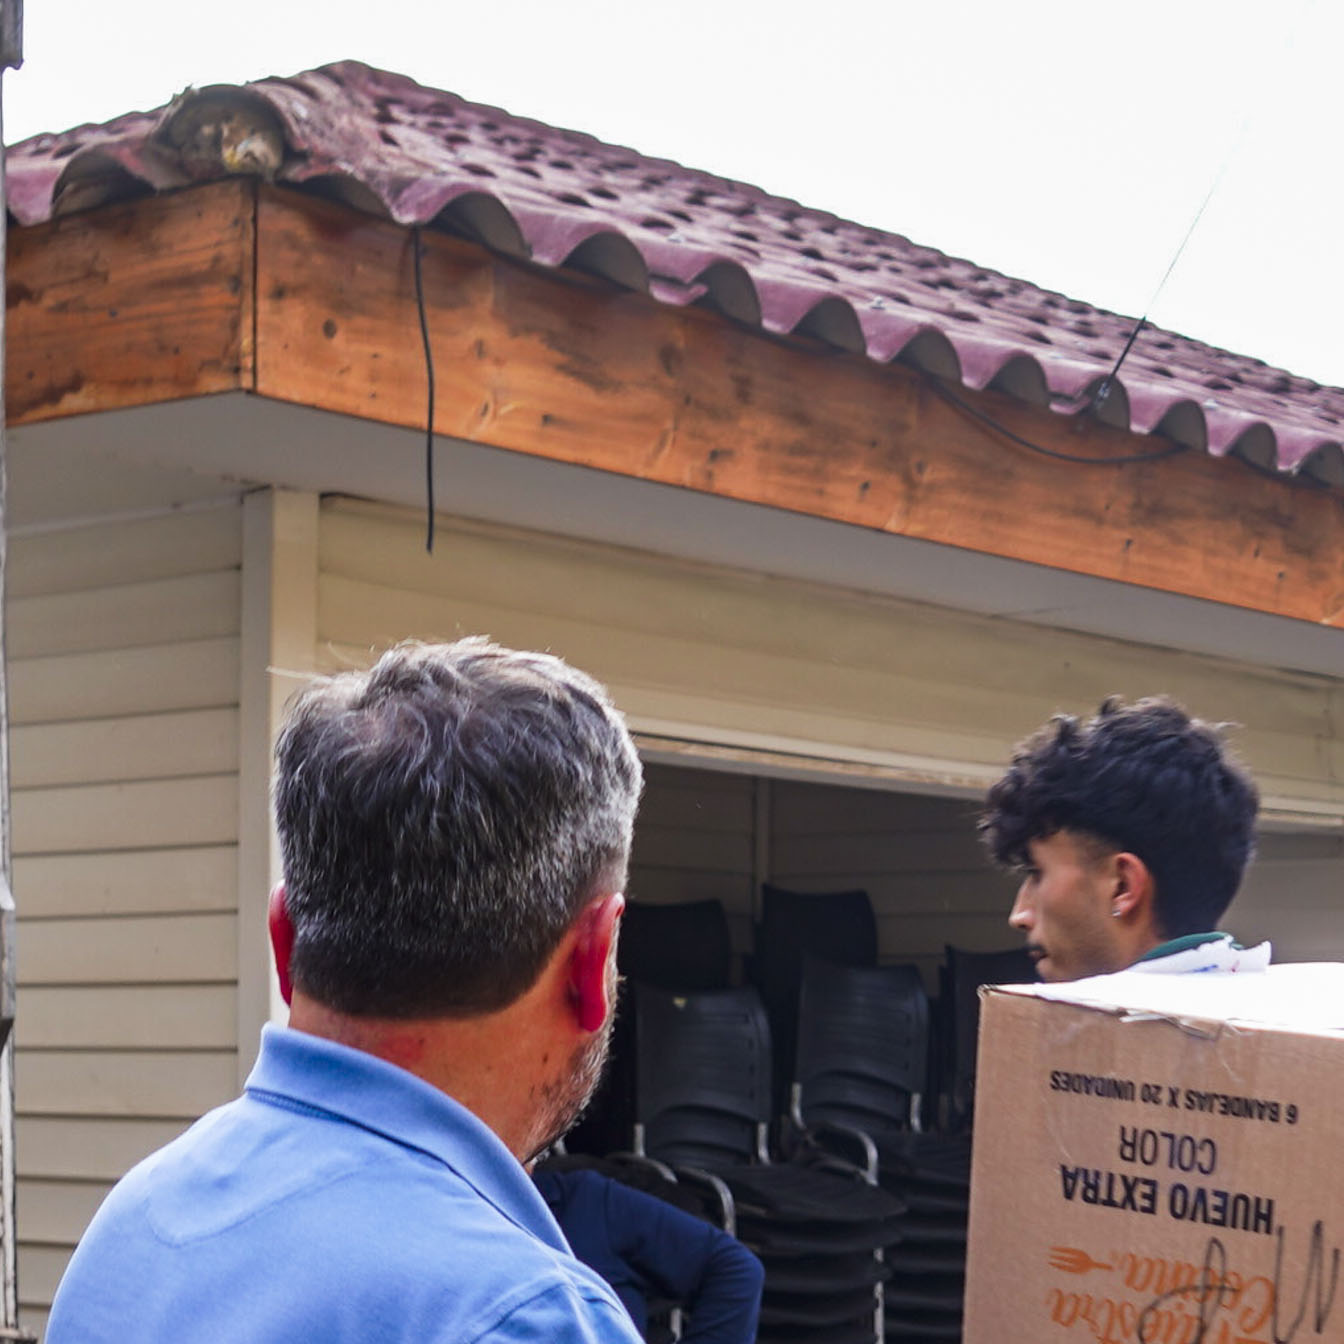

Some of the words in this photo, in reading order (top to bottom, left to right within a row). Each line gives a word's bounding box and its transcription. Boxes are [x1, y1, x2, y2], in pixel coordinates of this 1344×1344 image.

[1049, 1070, 1136, 1102] UNIDADES
[1140, 1083, 1162, 1105] 20
[1167, 1086, 1181, 1109] X
[1184, 1089, 1281, 1123] BANDEJAS
[1286, 1103, 1299, 1126] 6
[1119, 1125, 1217, 1176] COLOR
[1059, 1165, 1158, 1216] EXTRA
[1169, 1183, 1275, 1235] HUEVO
[1123, 1253, 1275, 1335] Cocina
